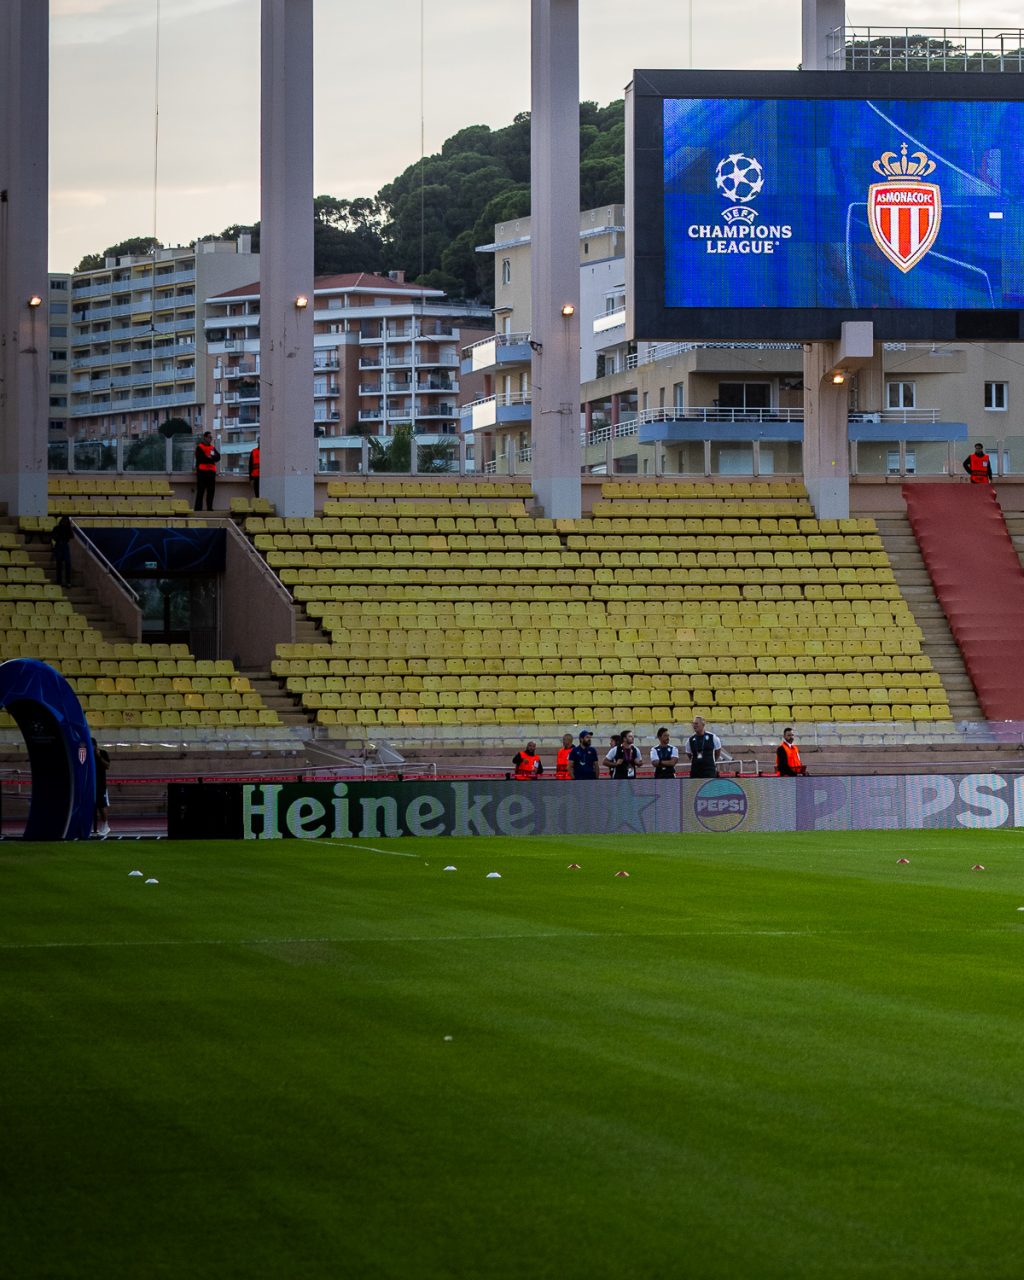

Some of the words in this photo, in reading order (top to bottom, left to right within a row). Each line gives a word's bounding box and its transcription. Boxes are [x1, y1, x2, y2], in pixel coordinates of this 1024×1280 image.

[724, 209, 755, 222] UEFA
[688, 225, 792, 238] CHAMPIONS
[706, 240, 774, 253] LEAGUE
[243, 782, 590, 840] Heineken
[696, 799, 745, 812] PEPSI
